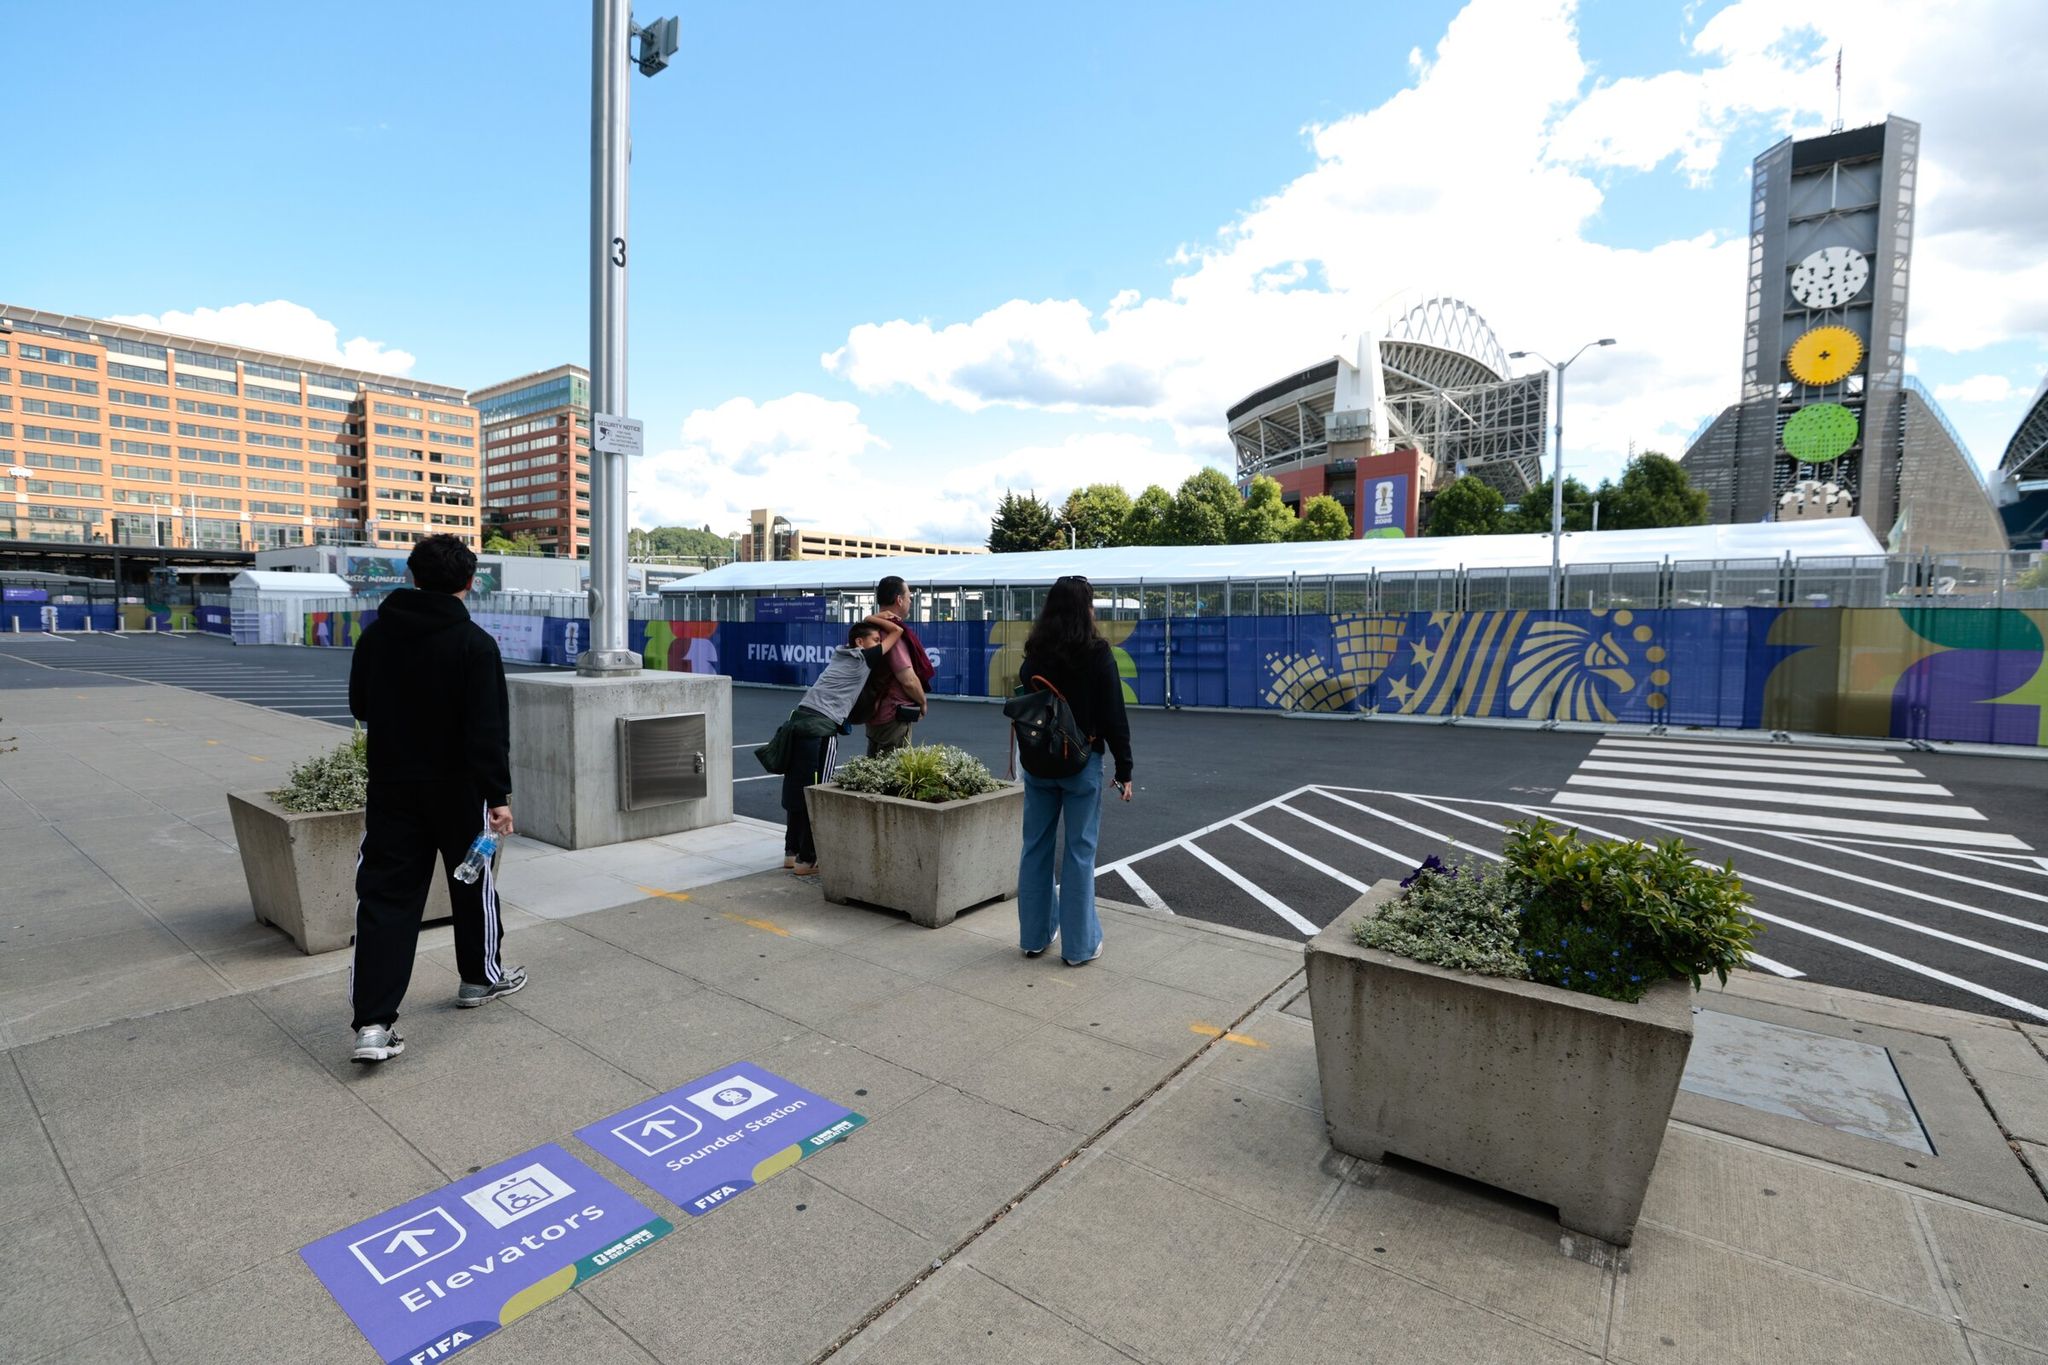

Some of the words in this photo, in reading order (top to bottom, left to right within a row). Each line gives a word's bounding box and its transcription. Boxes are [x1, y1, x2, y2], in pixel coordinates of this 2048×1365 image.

[612, 237, 626, 268] 3
[597, 420, 622, 429] SECURITY
[747, 643, 779, 662] FIFA
[665, 1128, 745, 1172] Sounder
[744, 1099, 808, 1133] Station
[694, 1185, 738, 1210] FIFA
[398, 1204, 605, 1313] Elevators
[409, 1330, 473, 1365] FIFA
